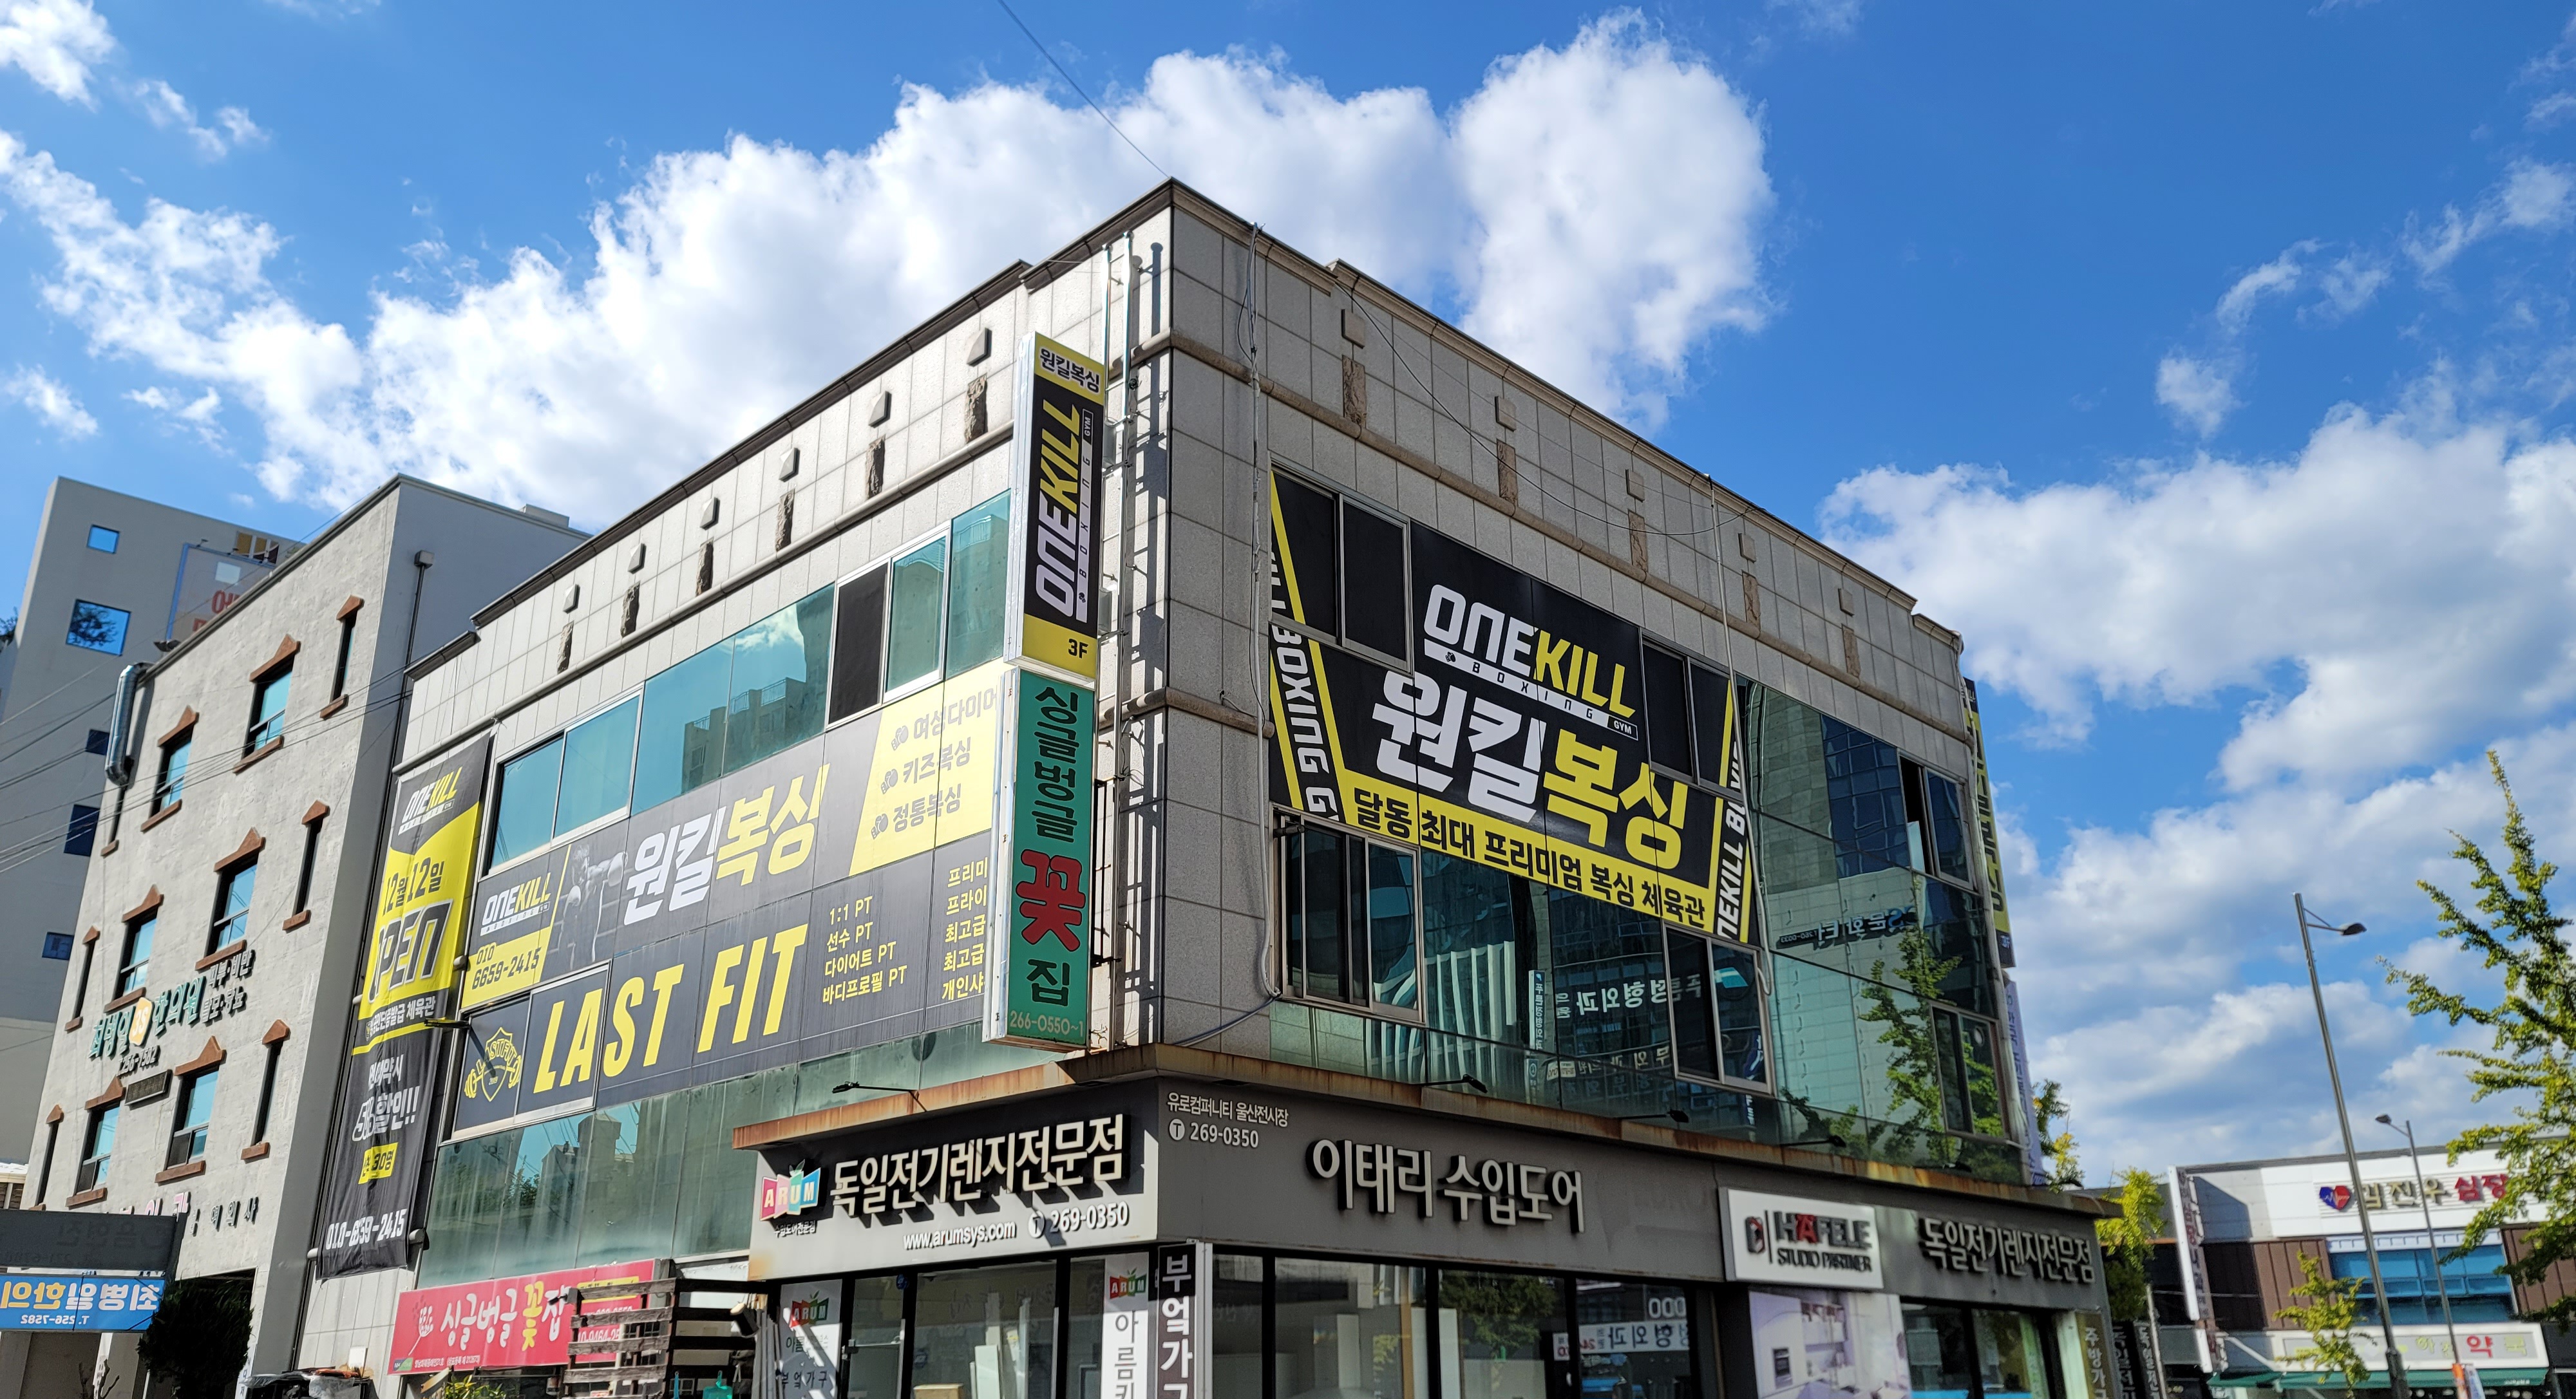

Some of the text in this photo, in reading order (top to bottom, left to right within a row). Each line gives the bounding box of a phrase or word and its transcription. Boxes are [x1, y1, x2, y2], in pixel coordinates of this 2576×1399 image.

[1040, 348, 1099, 393] 원킬복싱
[1083, 417, 1092, 437] GYM
[1036, 398, 1081, 617] ONEKILL
[1079, 456, 1090, 578] BOXING
[1068, 638, 1088, 659] 3F
[1424, 584, 1636, 718] ONEKILL
[1472, 661, 1593, 720] BOXING
[1614, 719, 1633, 735] GYM
[902, 737, 972, 784] 키즈복싱
[1030, 686, 1080, 843] 싱글벙글
[1372, 670, 1688, 870] 원킬복싱
[402, 767, 462, 823] ONEKILL
[893, 783, 962, 833] 정통복싱
[624, 762, 831, 926] 원킬복싱
[1353, 787, 1705, 928] 달동 최대 프리미엄 복싱 체육관
[482, 872, 551, 925] ONEKILL
[829, 896, 873, 926] 1:1 PT
[826, 922, 874, 953] 선수 PT
[945, 914, 986, 944] 최고급
[471, 947, 542, 990] 6659-2415
[477, 947, 494, 965] 010
[824, 941, 897, 978] 다이어트 PT
[943, 942, 985, 972] 최고급
[152, 975, 205, 1037] 한의원
[822, 964, 908, 1005] 바디프로필 PT
[406, 995, 437, 1020] 체육관
[534, 924, 808, 1093] LAST FIT
[1009, 1009, 1084, 1038] 266-0550~1
[1167, 1092, 1289, 1127] 유로컴퍼니티 울산전시장
[1189, 1122, 1259, 1148] 269-0350
[371, 1149, 394, 1172] 30명
[830, 1113, 1124, 1216] 독일전기렌지전문점
[764, 1181, 815, 1208] ARUM
[1312, 1138, 1584, 1234] 이태리 수입도어
[210, 1197, 259, 1231] 여의사
[903, 1221, 1017, 1250] www.arumsys.com
[1050, 1201, 1129, 1235] 269-0350
[1777, 1247, 1821, 1268] STUDIO
[1924, 1217, 2096, 1283] 독일전기렌지전문점
[1111, 1281, 1146, 1294] ARUM
[440, 1288, 518, 1351] 싱글벙글
[793, 1305, 827, 1320] ARUM
